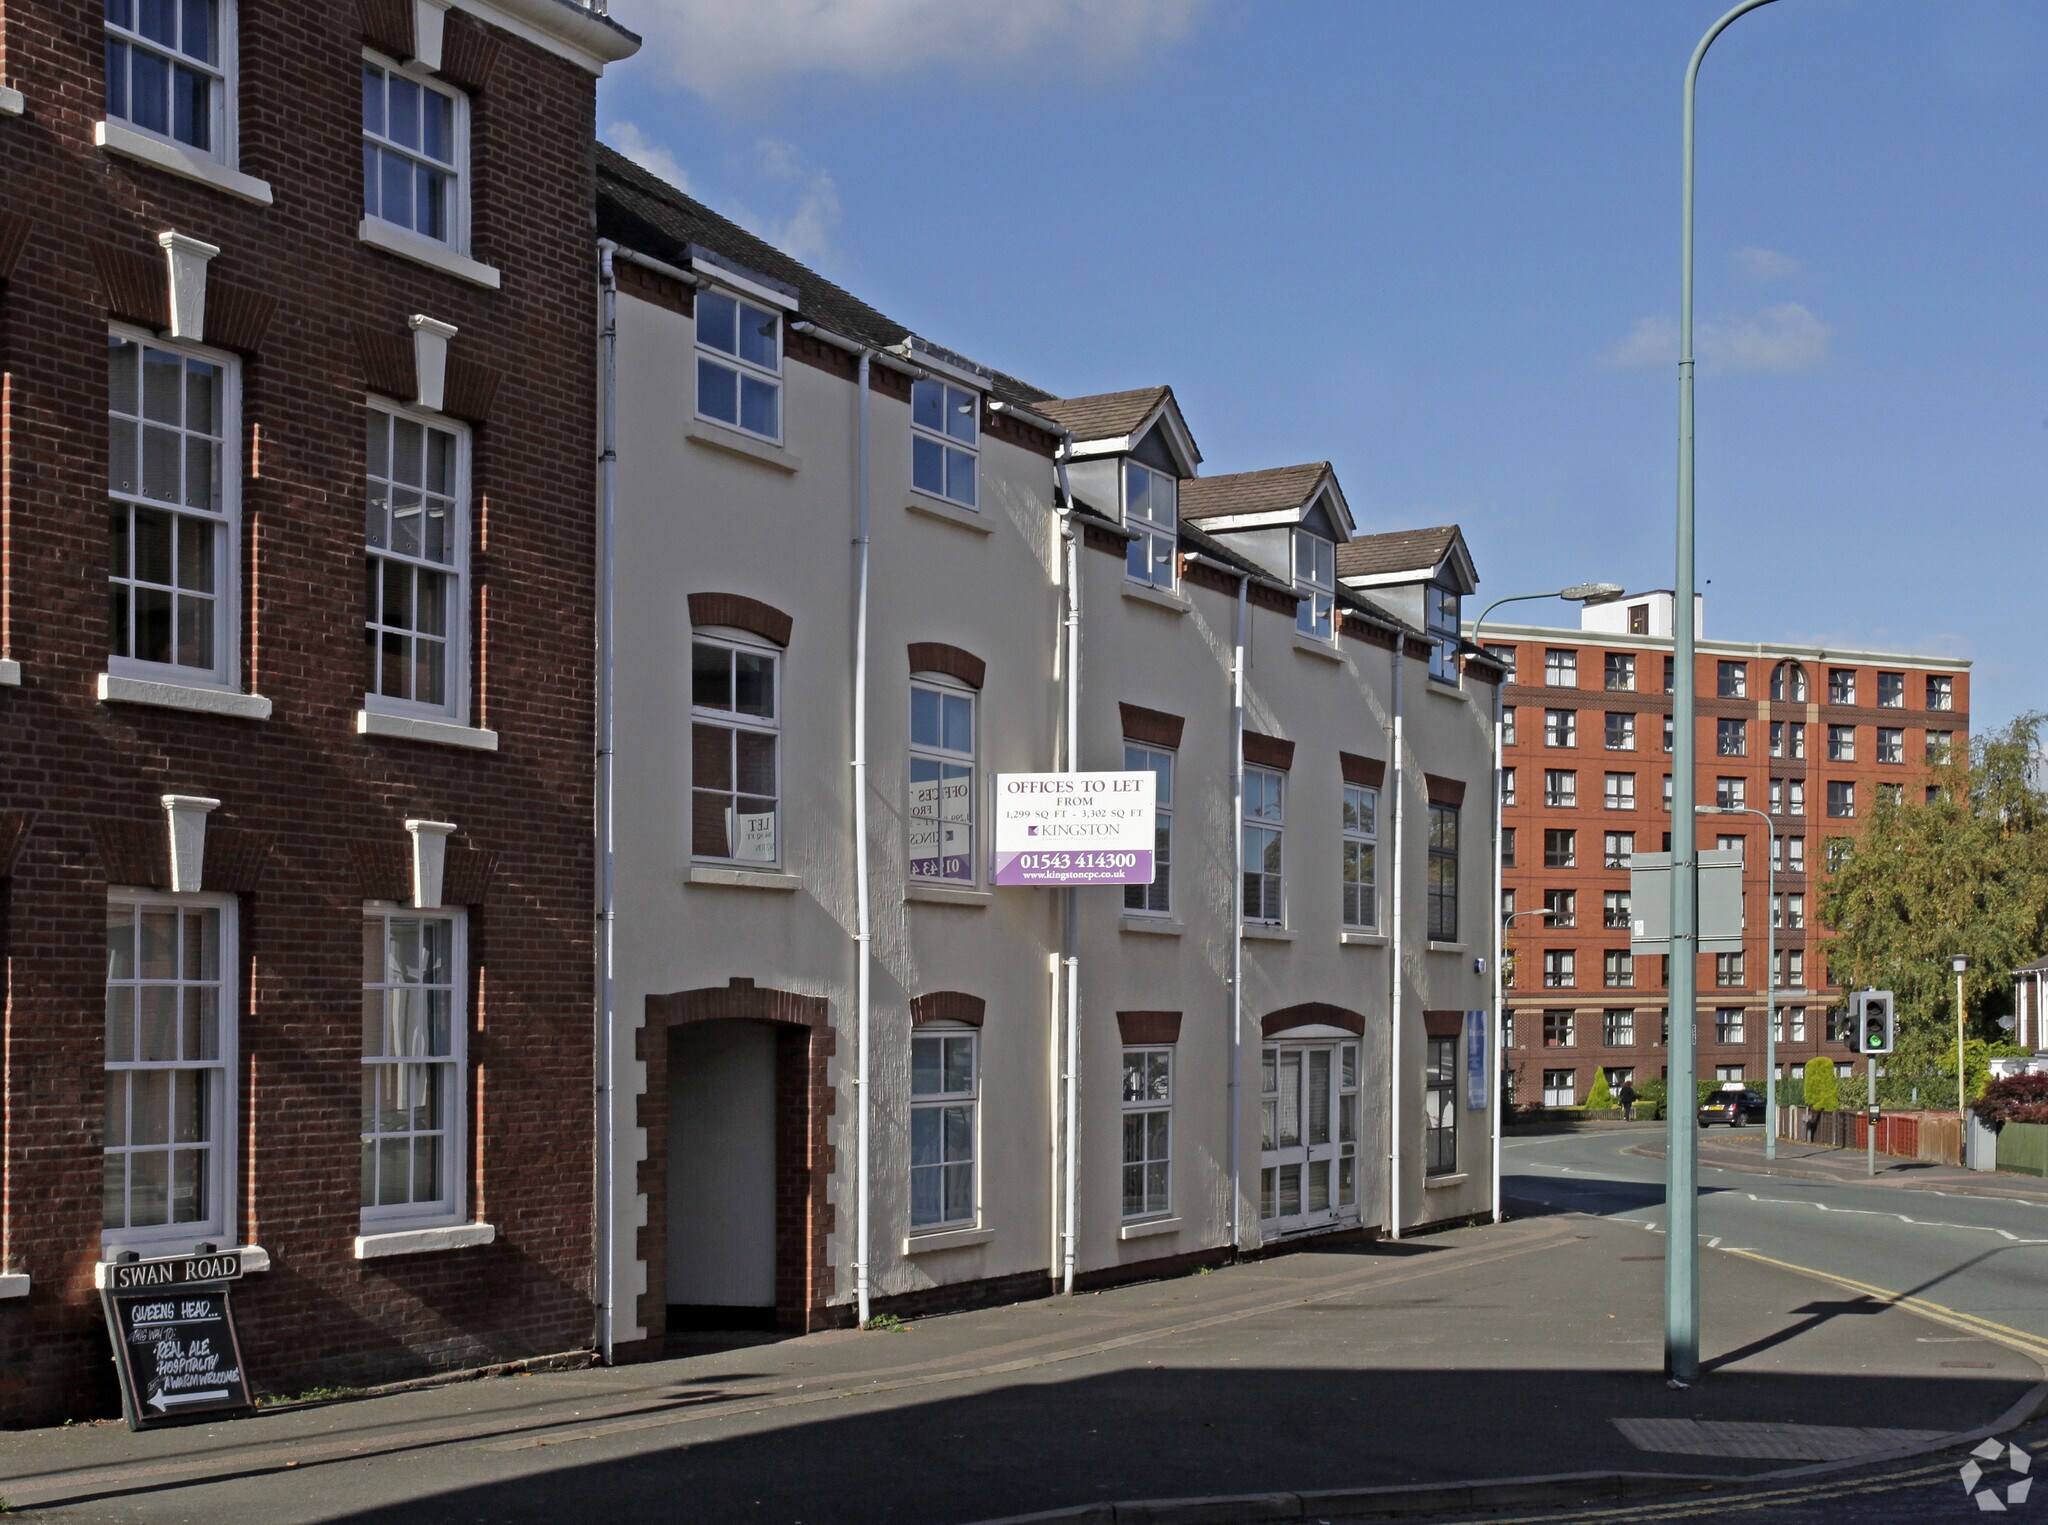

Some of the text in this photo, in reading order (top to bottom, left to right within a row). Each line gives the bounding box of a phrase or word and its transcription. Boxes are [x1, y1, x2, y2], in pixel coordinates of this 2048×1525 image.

[1007, 780, 1144, 794] OFFICES TO LET
[1056, 797, 1094, 806] FROM
[1006, 810, 1031, 819] 1,299
[1035, 810, 1049, 819] SQ
[1054, 810, 1068, 818] FT
[1081, 809, 1106, 818] 3,302
[1111, 809, 1125, 818] SQ
[1130, 809, 1144, 817] FT
[1042, 824, 1120, 836] KINGSTON
[1020, 852, 1137, 870] 01543 414300
[1023, 869, 1126, 881] www.kingstoncpc.co.uk
[119, 1256, 237, 1288] SWAN ROAD
[131, 1302, 175, 1322] QUEENS
[156, 1341, 184, 1360] REAL
[157, 1353, 219, 1375] HOSPITALITY
[164, 1376, 171, 1391] A
[170, 1374, 199, 1390] WARM
